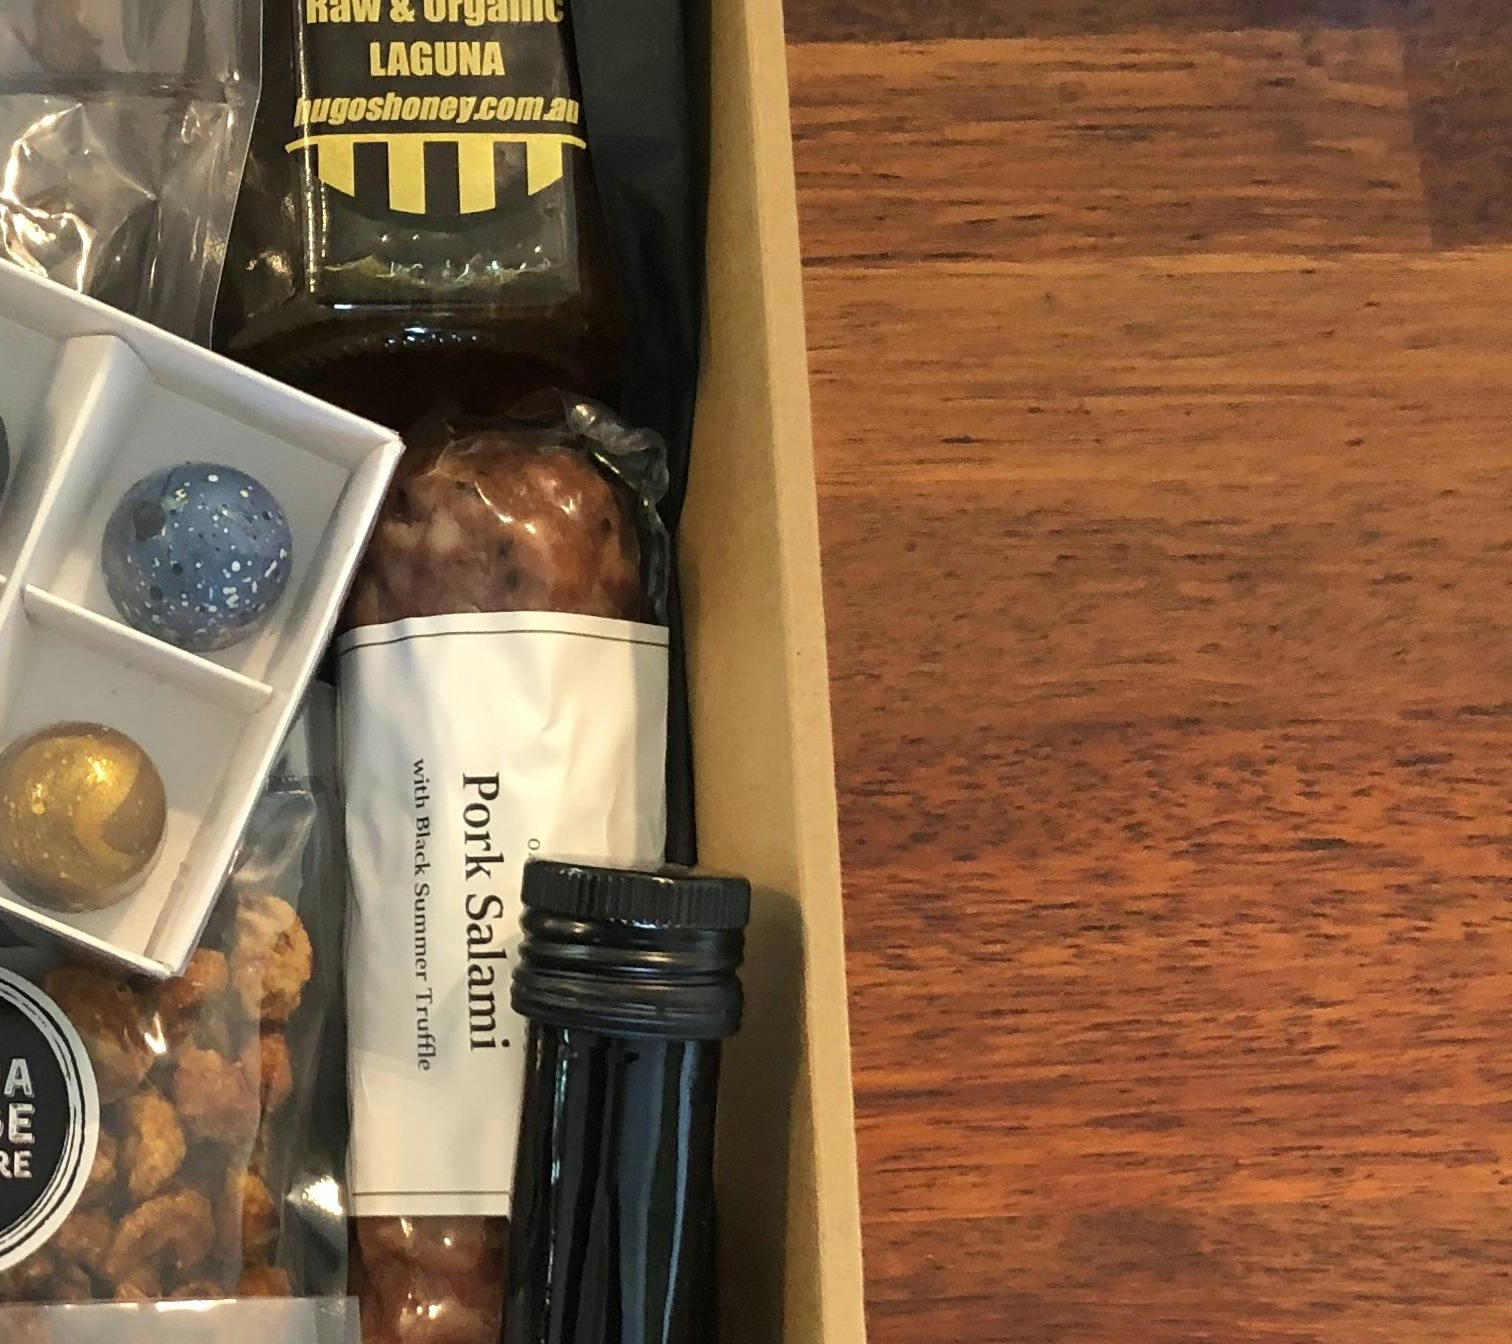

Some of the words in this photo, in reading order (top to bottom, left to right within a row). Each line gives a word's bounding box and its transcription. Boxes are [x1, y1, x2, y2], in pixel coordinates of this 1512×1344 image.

[368, 40, 506, 78] LAGUNA
[293, 90, 581, 129] hugoshoney.com.au
[412, 757, 431, 810] with
[413, 816, 431, 877] Black
[462, 771, 506, 882] Pork
[413, 881, 431, 982] Summer
[464, 892, 511, 1053] Salami
[415, 986, 437, 1072] Truffle
